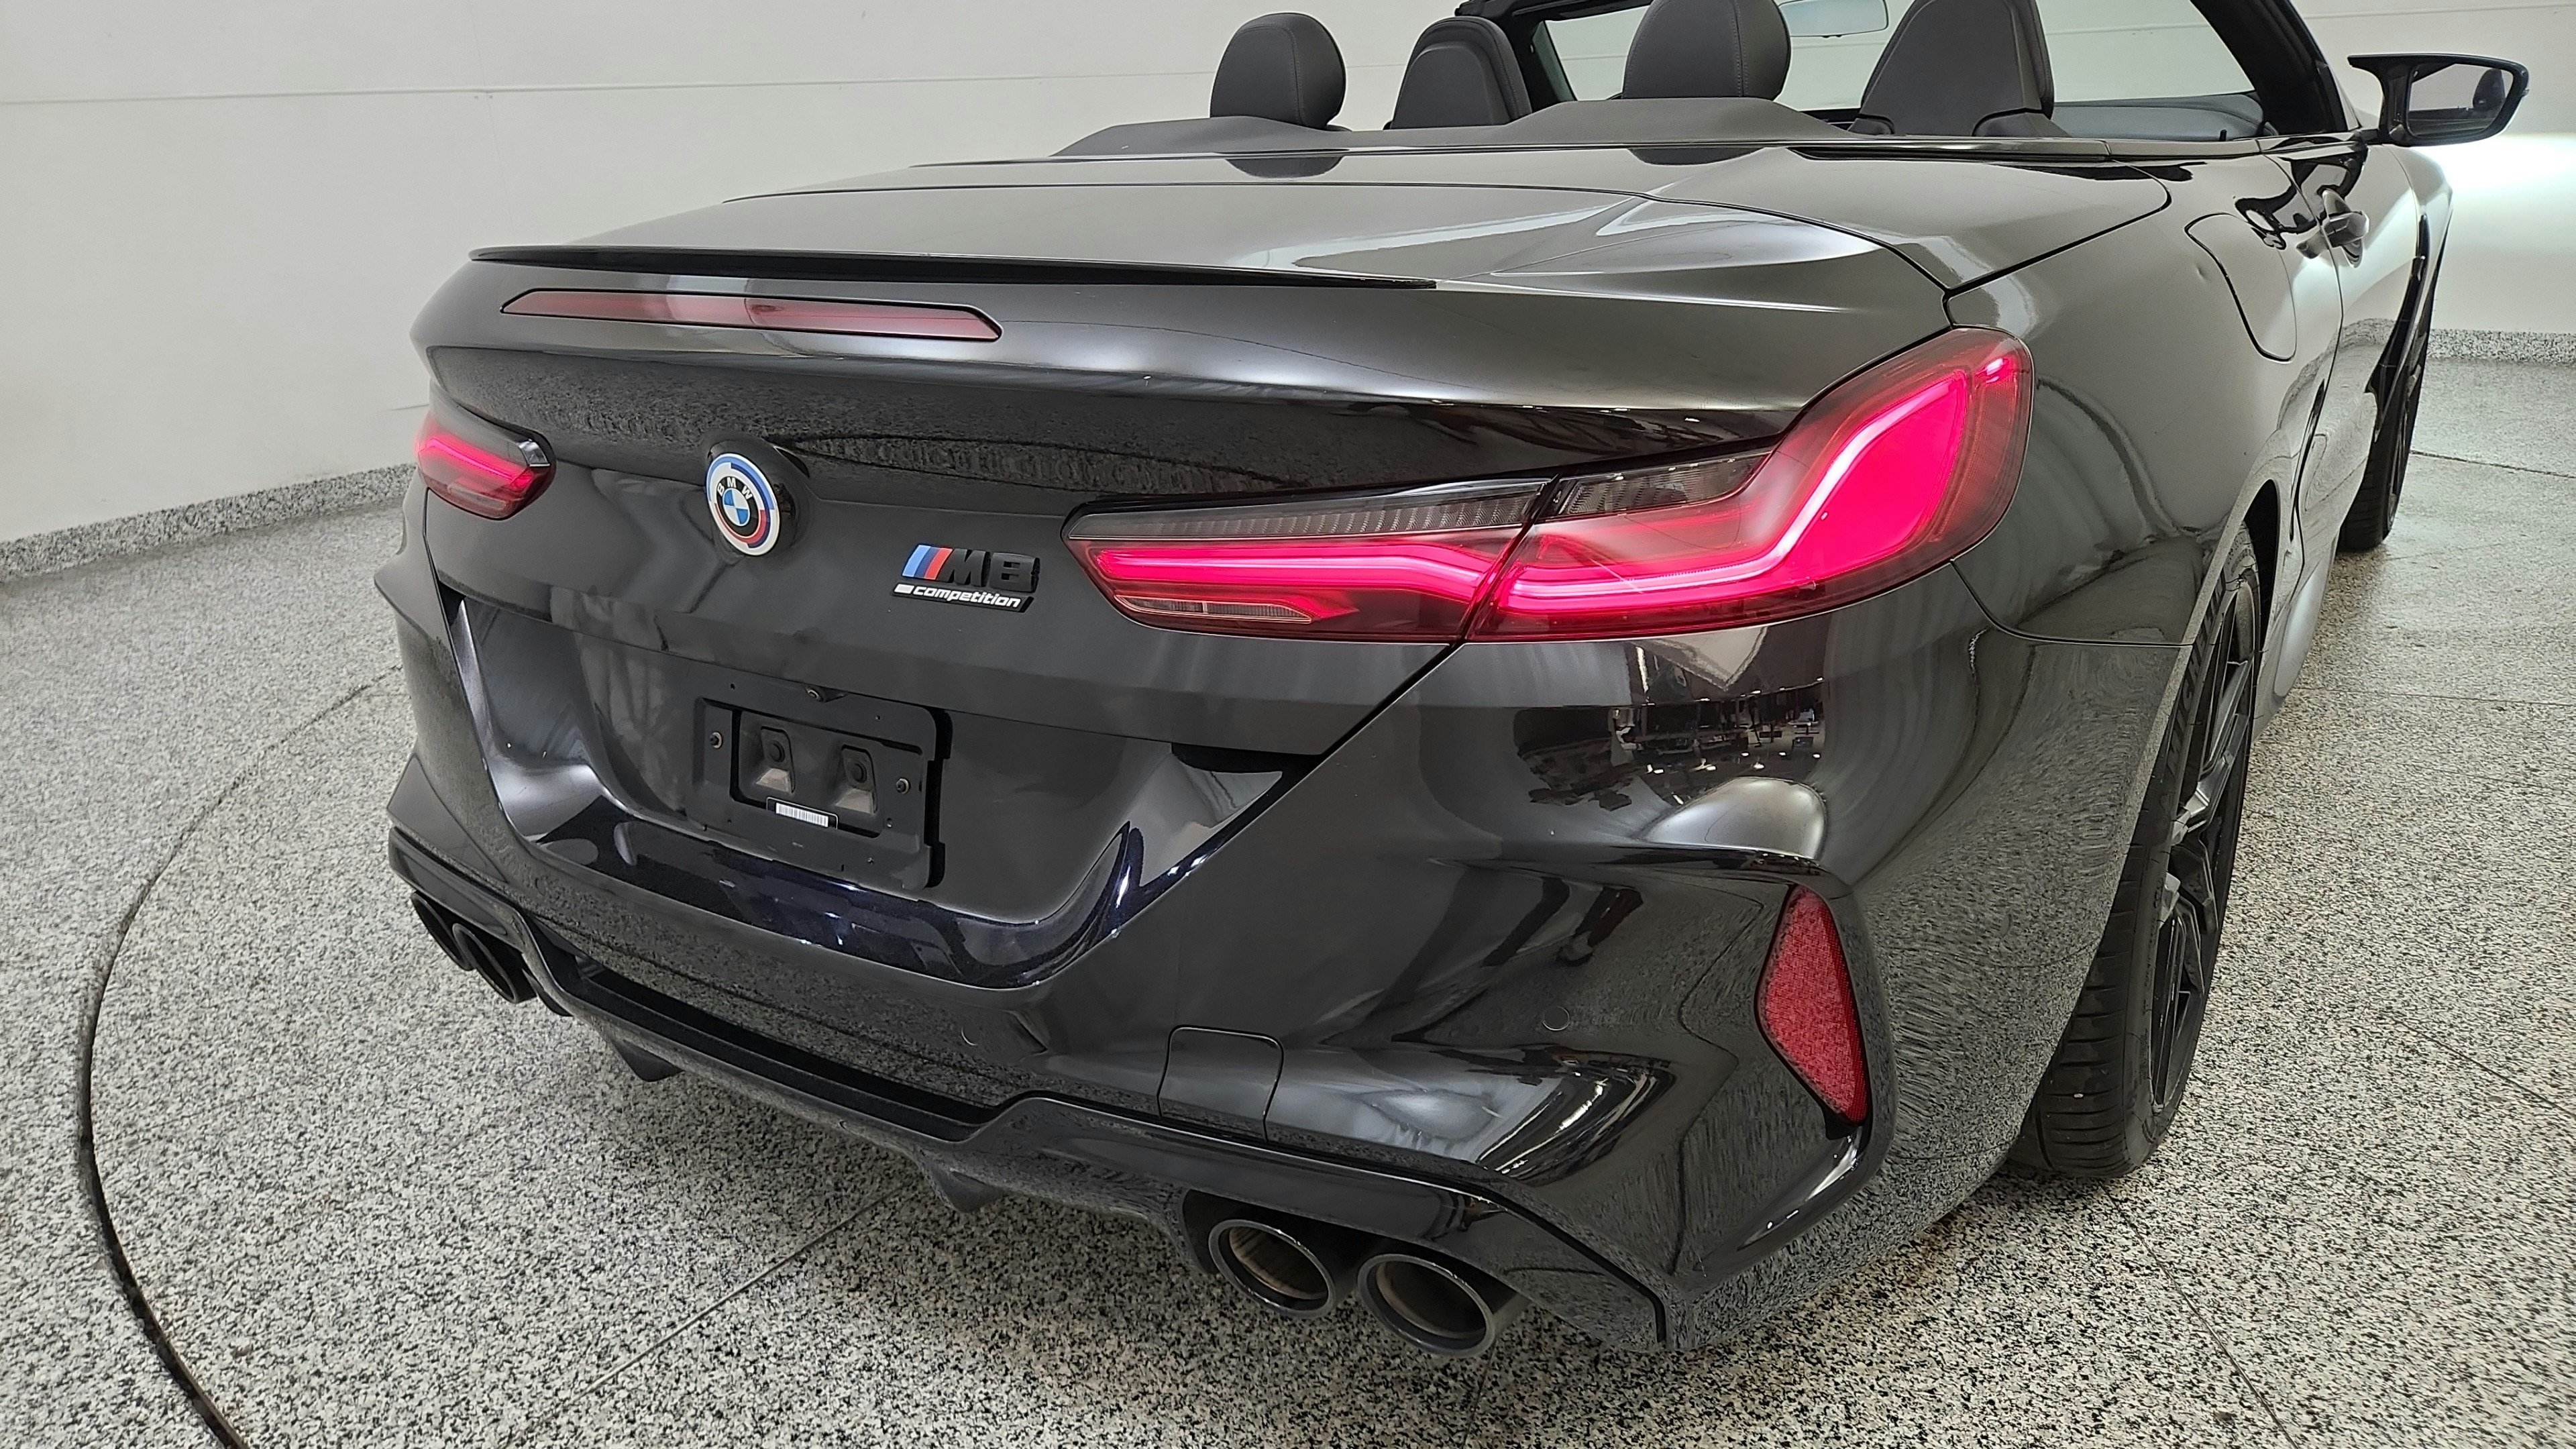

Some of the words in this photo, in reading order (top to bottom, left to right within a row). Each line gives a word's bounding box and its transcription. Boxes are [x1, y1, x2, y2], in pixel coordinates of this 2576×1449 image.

[717, 477, 753, 500] BMW
[936, 547, 1038, 592] M8
[913, 585, 1021, 608] competition
